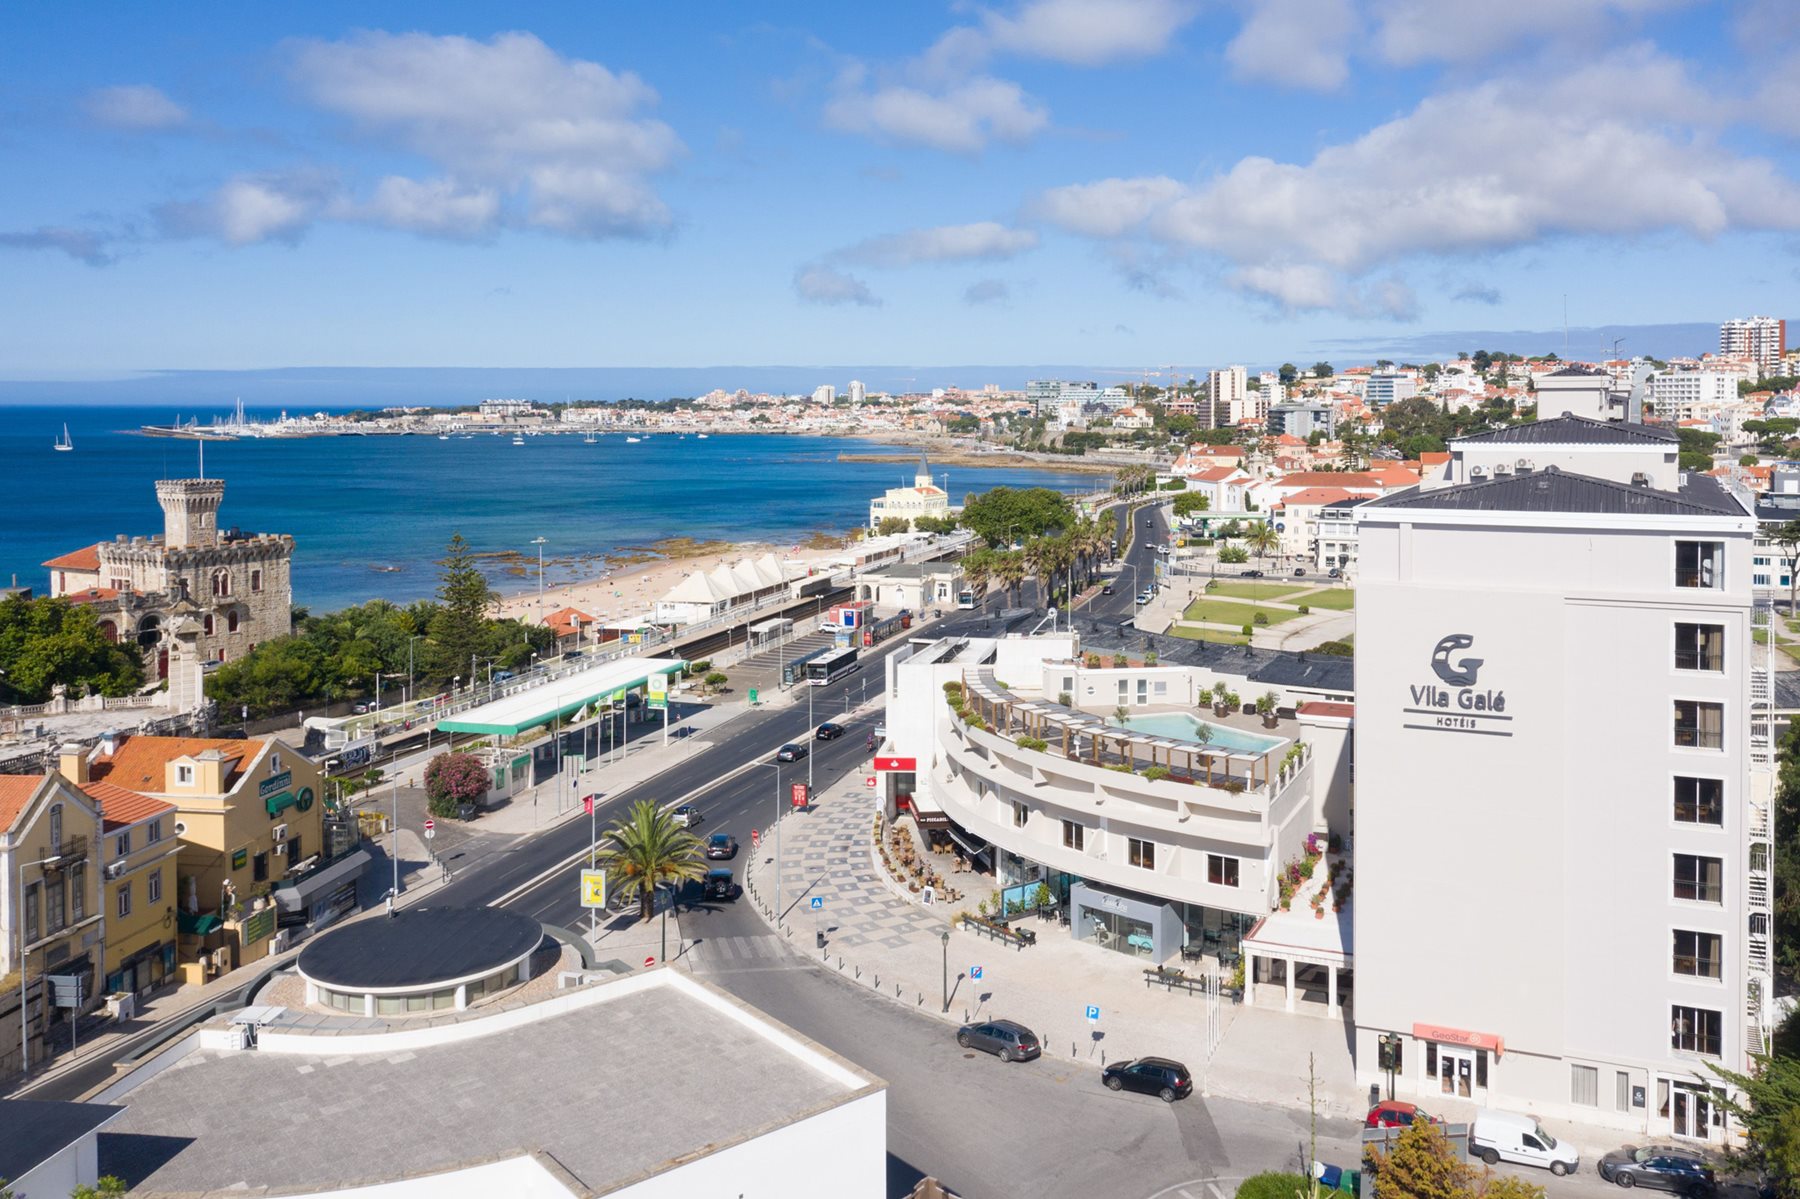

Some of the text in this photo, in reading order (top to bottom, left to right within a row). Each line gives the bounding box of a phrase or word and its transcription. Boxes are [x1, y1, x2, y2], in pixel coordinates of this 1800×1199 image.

[1410, 684, 1506, 713] Vila Galé
[1437, 716, 1476, 729] HOTÉIS
[1088, 1007, 1097, 1018] P
[1432, 1030, 1469, 1042] GeoStar
